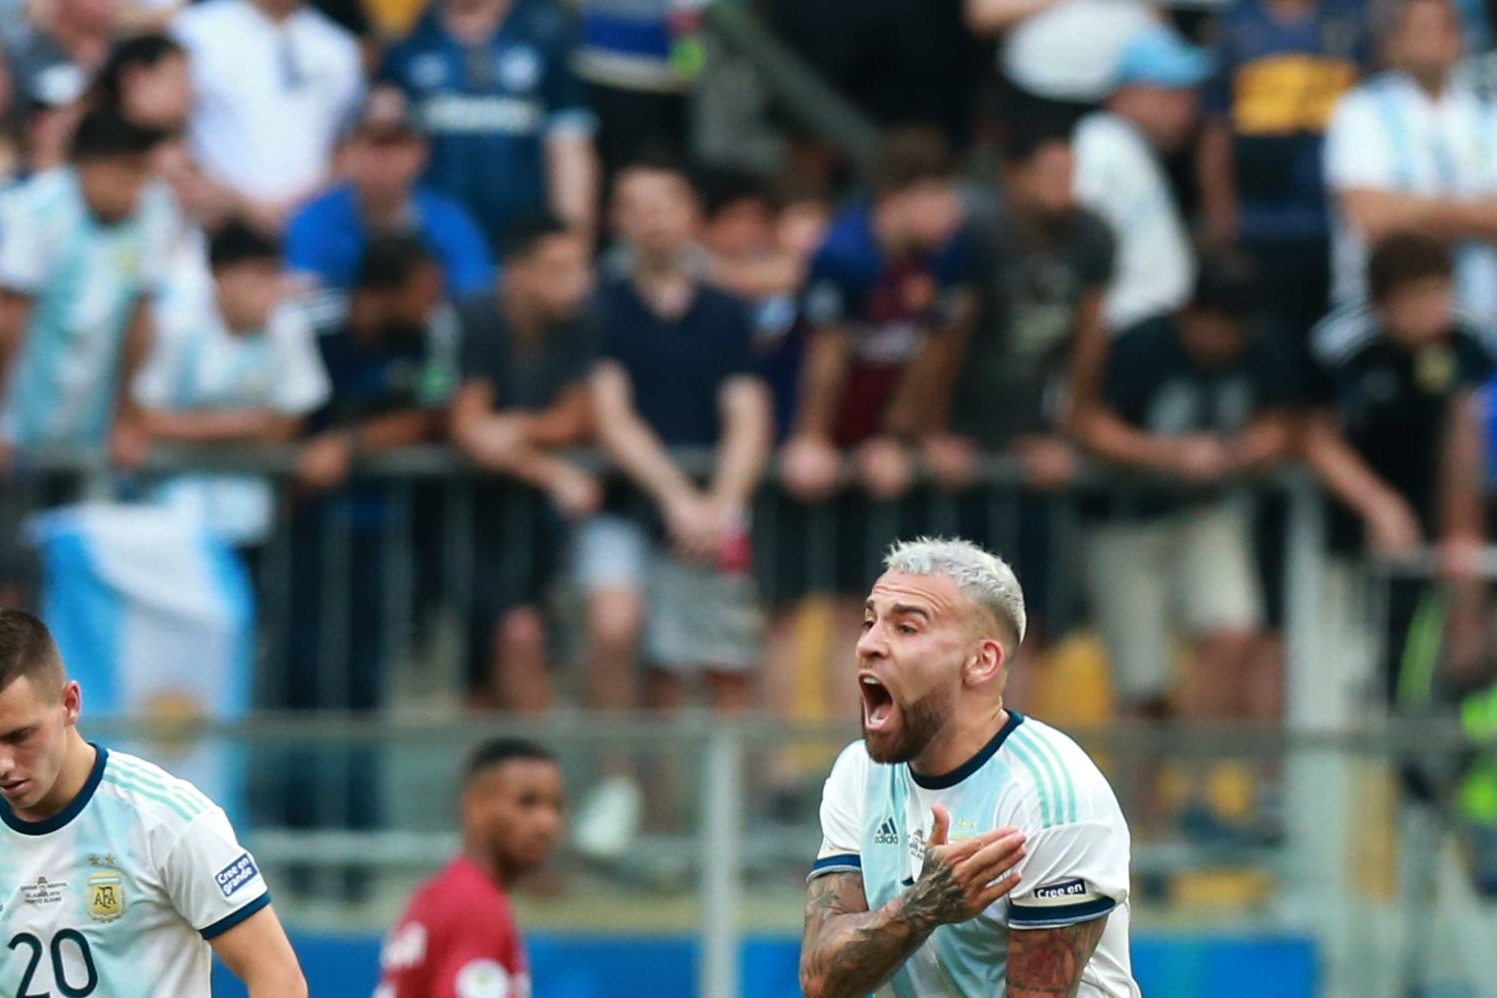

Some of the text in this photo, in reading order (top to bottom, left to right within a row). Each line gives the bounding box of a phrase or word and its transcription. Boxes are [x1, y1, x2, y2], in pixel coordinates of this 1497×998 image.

[874, 835, 899, 845] adida
[217, 857, 250, 884] Cree en
[223, 867, 253, 895] grande
[1037, 883, 1082, 898] Cree en
